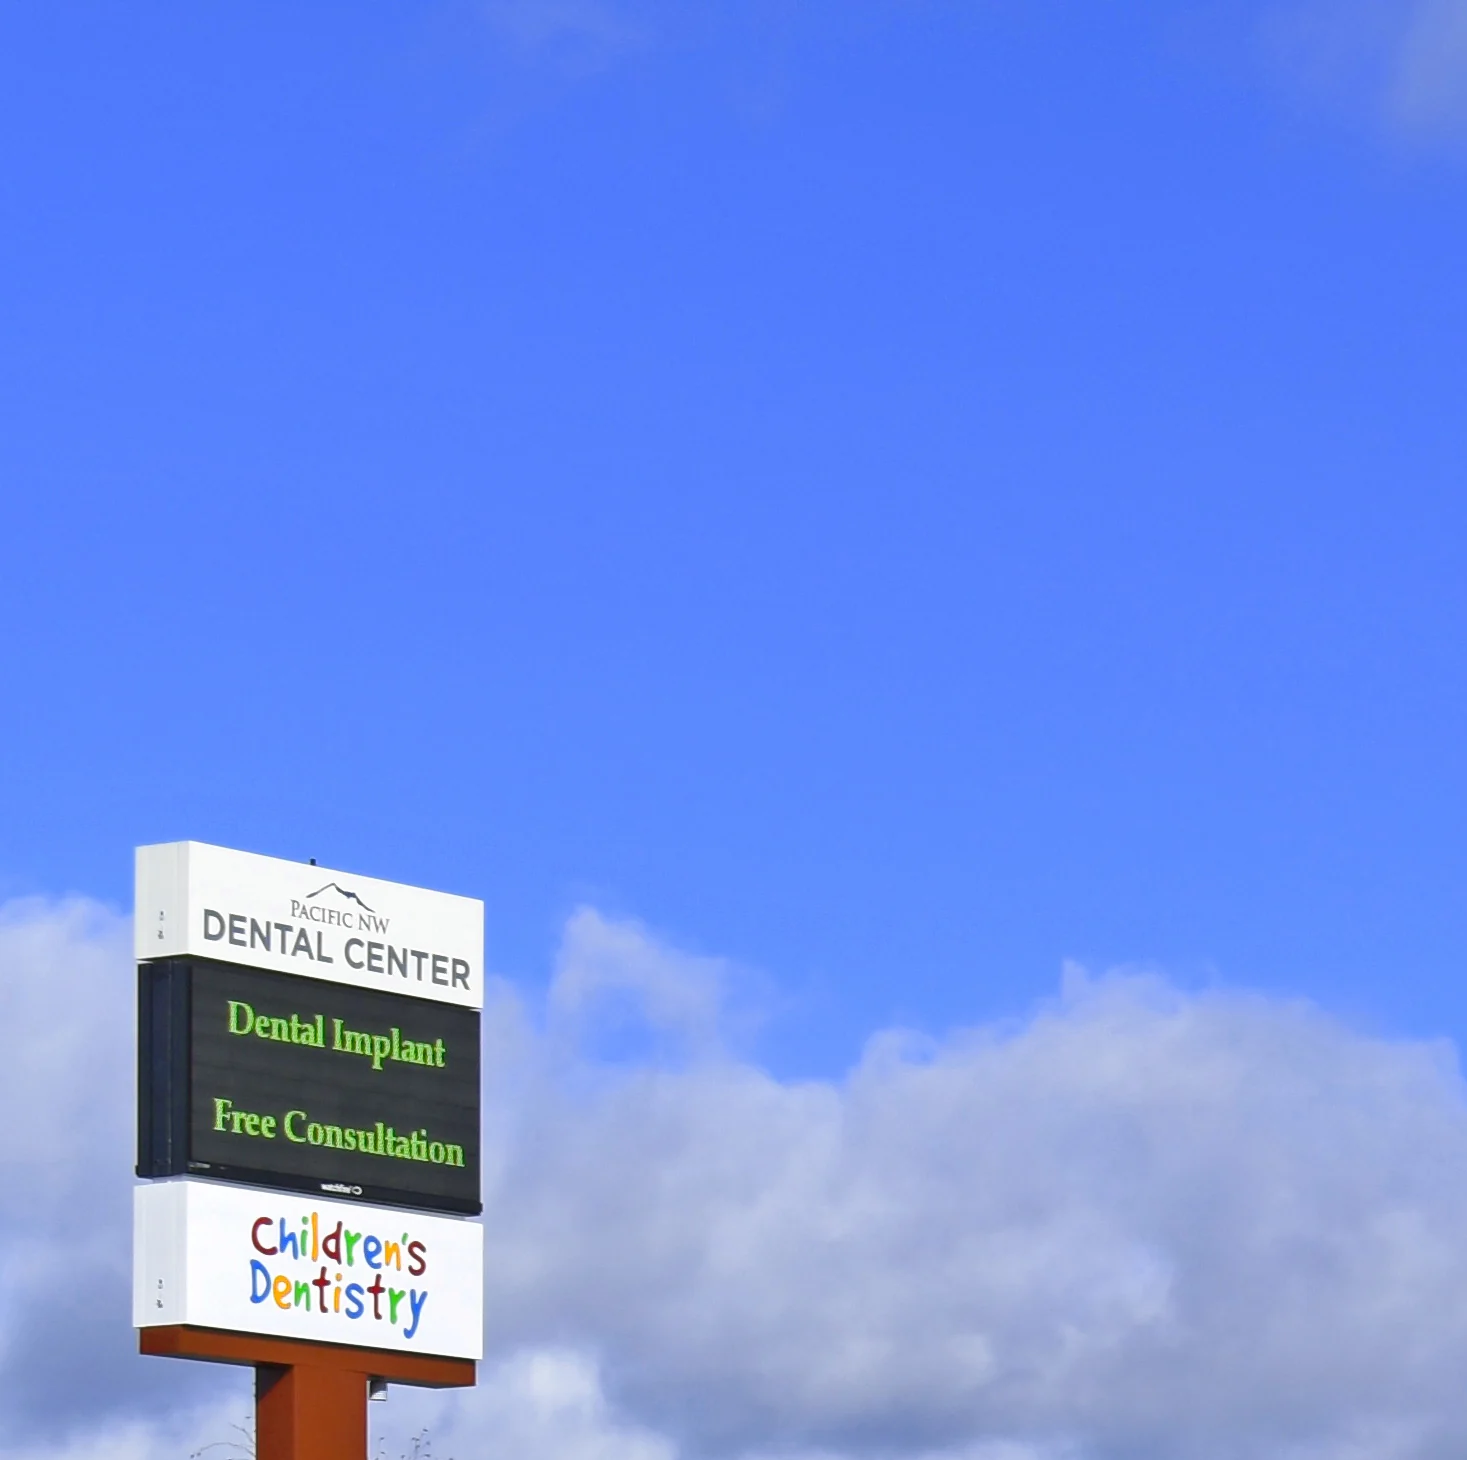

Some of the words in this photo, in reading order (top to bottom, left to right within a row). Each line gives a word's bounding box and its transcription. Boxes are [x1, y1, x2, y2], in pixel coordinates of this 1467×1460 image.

[203, 908, 334, 964] DENTAL
[344, 937, 471, 991] CENTER
[290, 898, 353, 929] PACIFIC
[358, 913, 390, 935] NW
[227, 1000, 326, 1048] Dental
[332, 1018, 446, 1070] Implant
[213, 1097, 277, 1139] Free
[283, 1110, 466, 1168] Consultation
[251, 1211, 427, 1276] Children's
[250, 1259, 428, 1339] Dentistry
